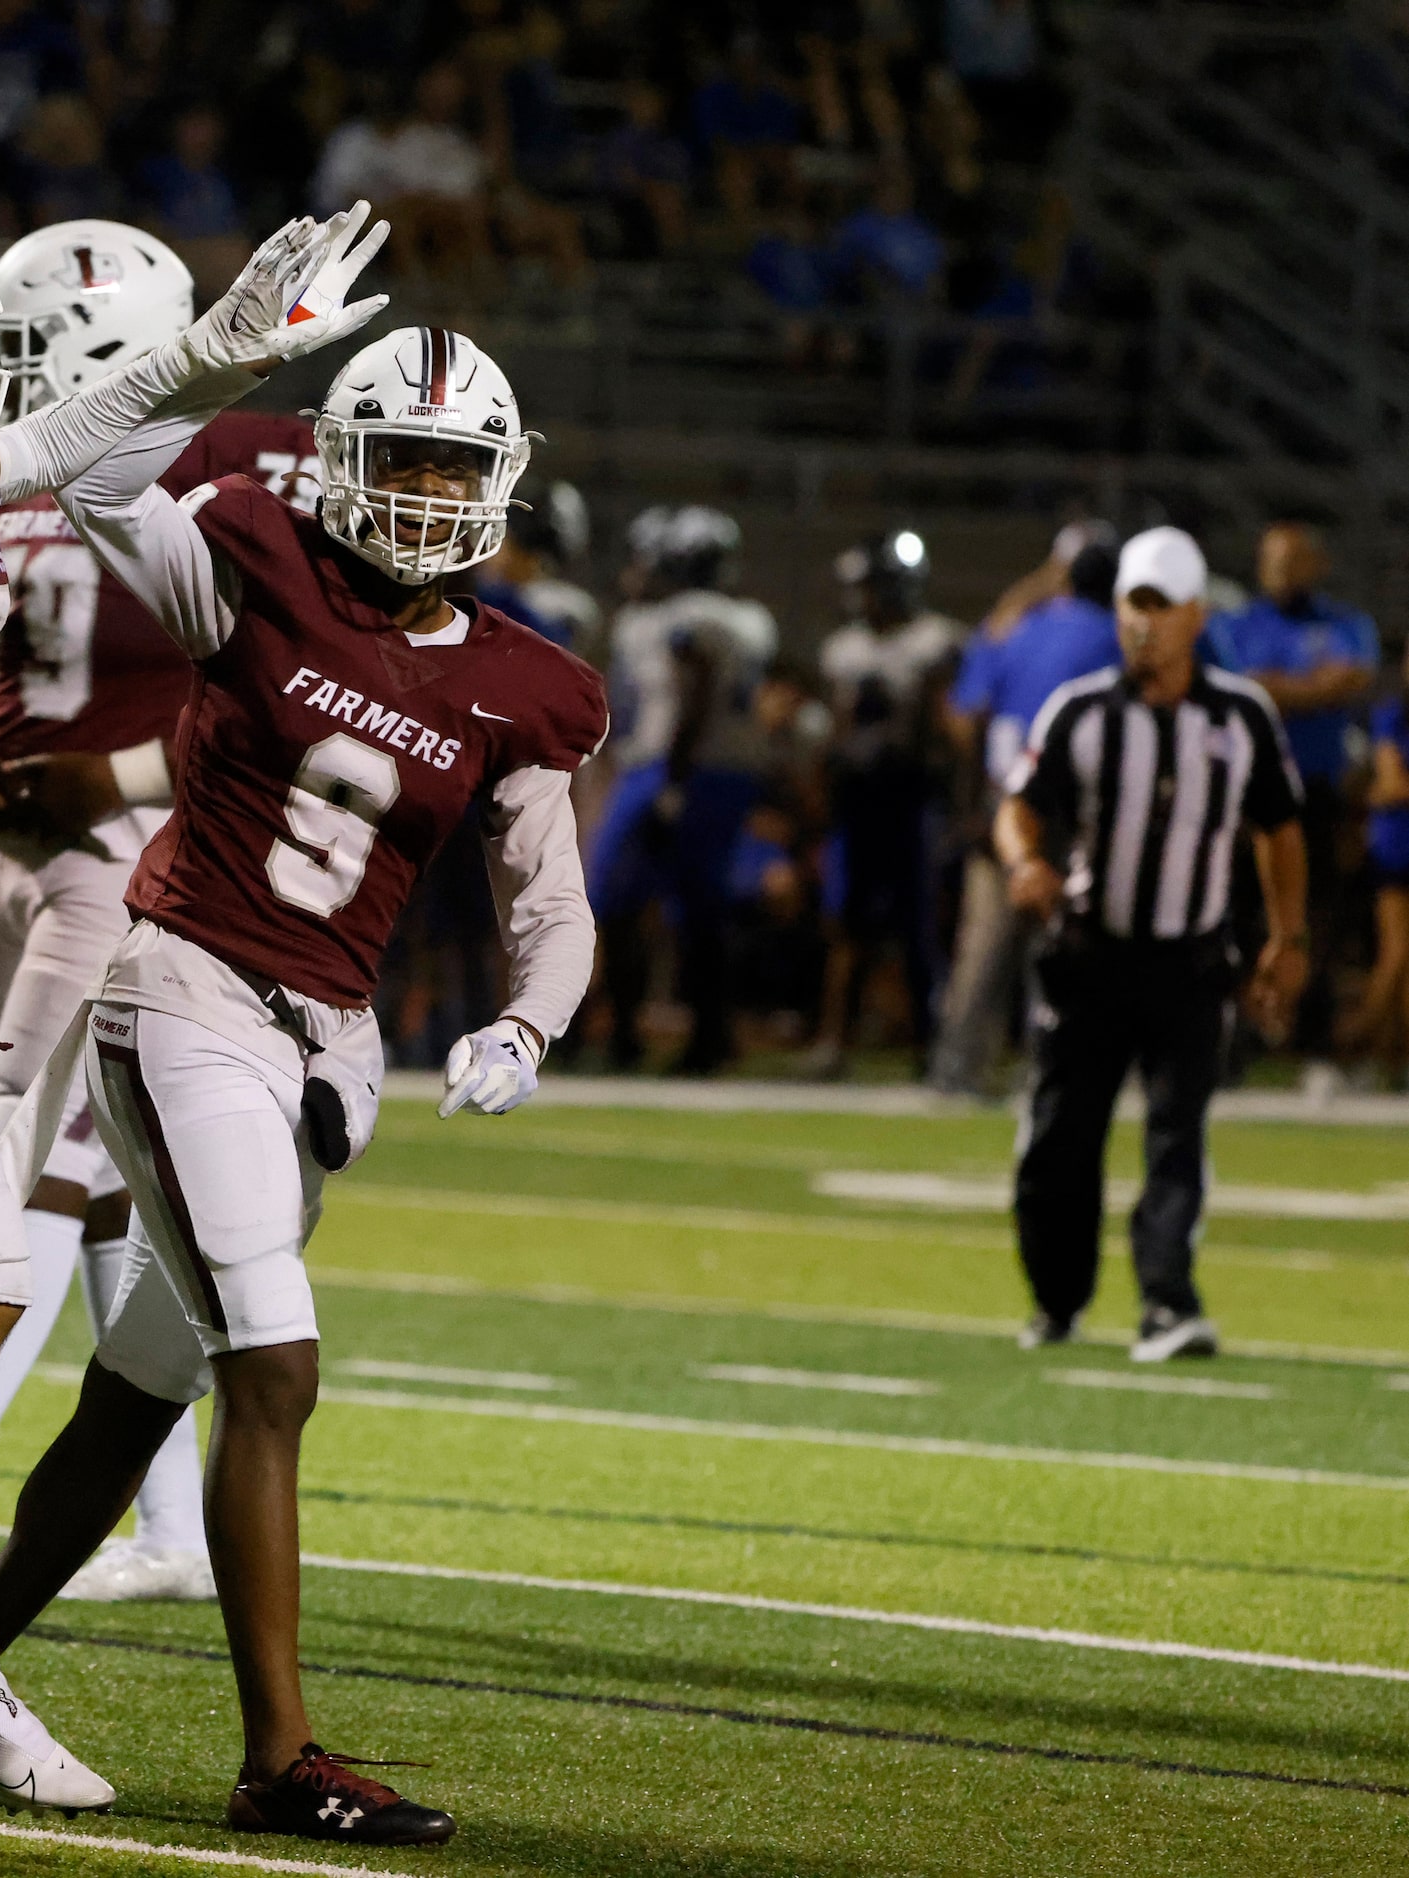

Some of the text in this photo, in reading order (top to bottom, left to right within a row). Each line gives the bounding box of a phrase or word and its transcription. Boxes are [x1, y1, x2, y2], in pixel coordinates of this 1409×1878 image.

[282, 666, 463, 771] FARMERS
[264, 731, 402, 919] 9
[93, 1014, 131, 1037] FARMERS
